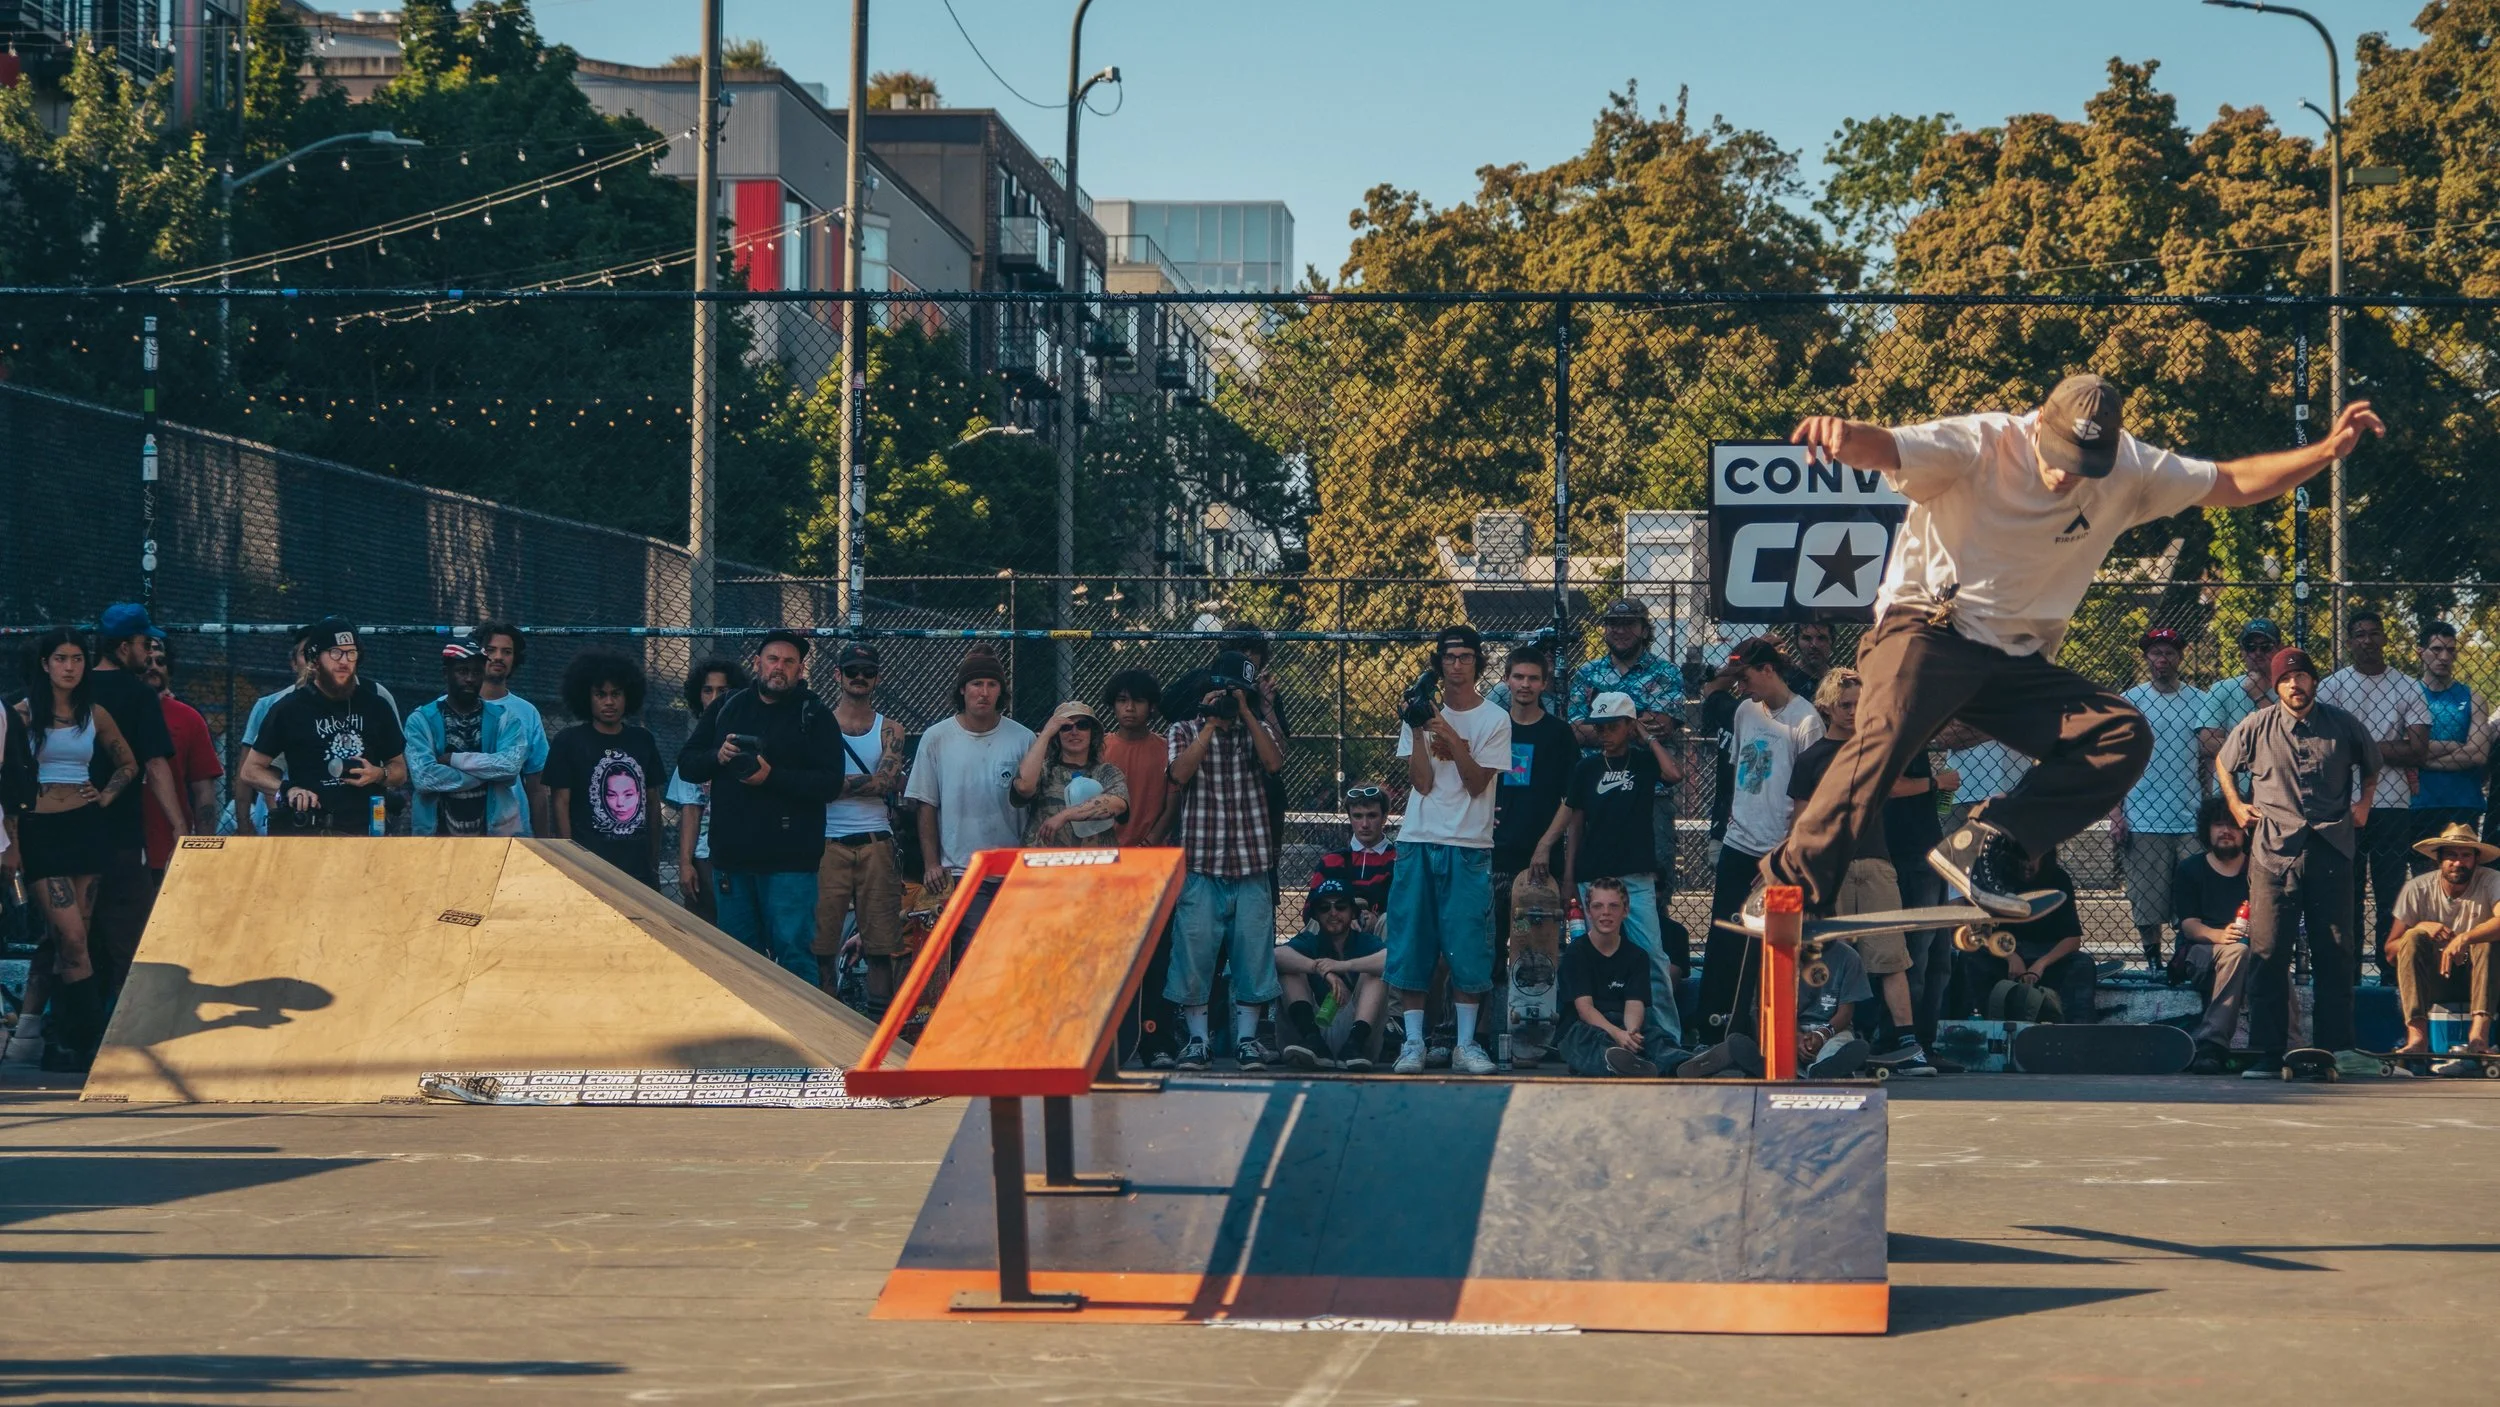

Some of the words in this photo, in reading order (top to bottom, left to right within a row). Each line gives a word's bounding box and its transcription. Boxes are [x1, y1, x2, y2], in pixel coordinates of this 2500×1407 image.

[1724, 456, 1899, 494] CONV
[1725, 521, 1903, 607] CO
[1602, 770, 1630, 782] NIKE
[1621, 781, 1634, 791] SB
[804, 1088, 847, 1097] CON
